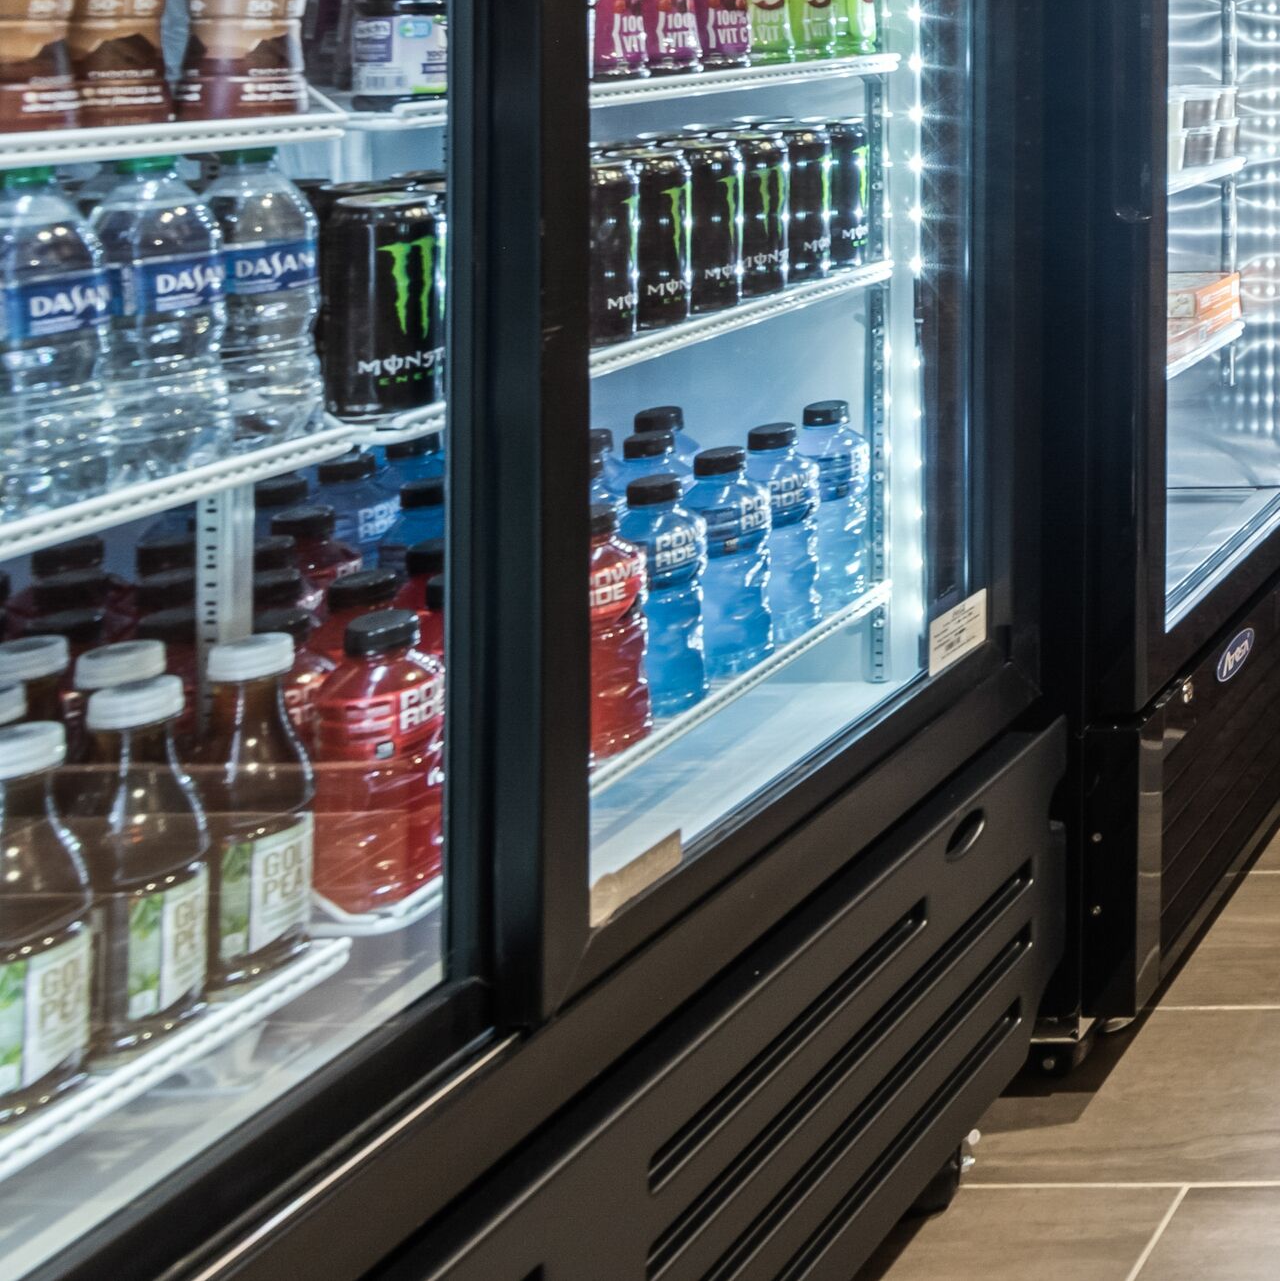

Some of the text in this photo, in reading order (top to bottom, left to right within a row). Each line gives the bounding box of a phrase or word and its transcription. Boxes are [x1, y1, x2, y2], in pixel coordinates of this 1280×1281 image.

[622, 15, 644, 32] 100
[717, 28, 739, 44] VIT
[235, 252, 314, 279] DASAN
[656, 546, 697, 569] ADE
